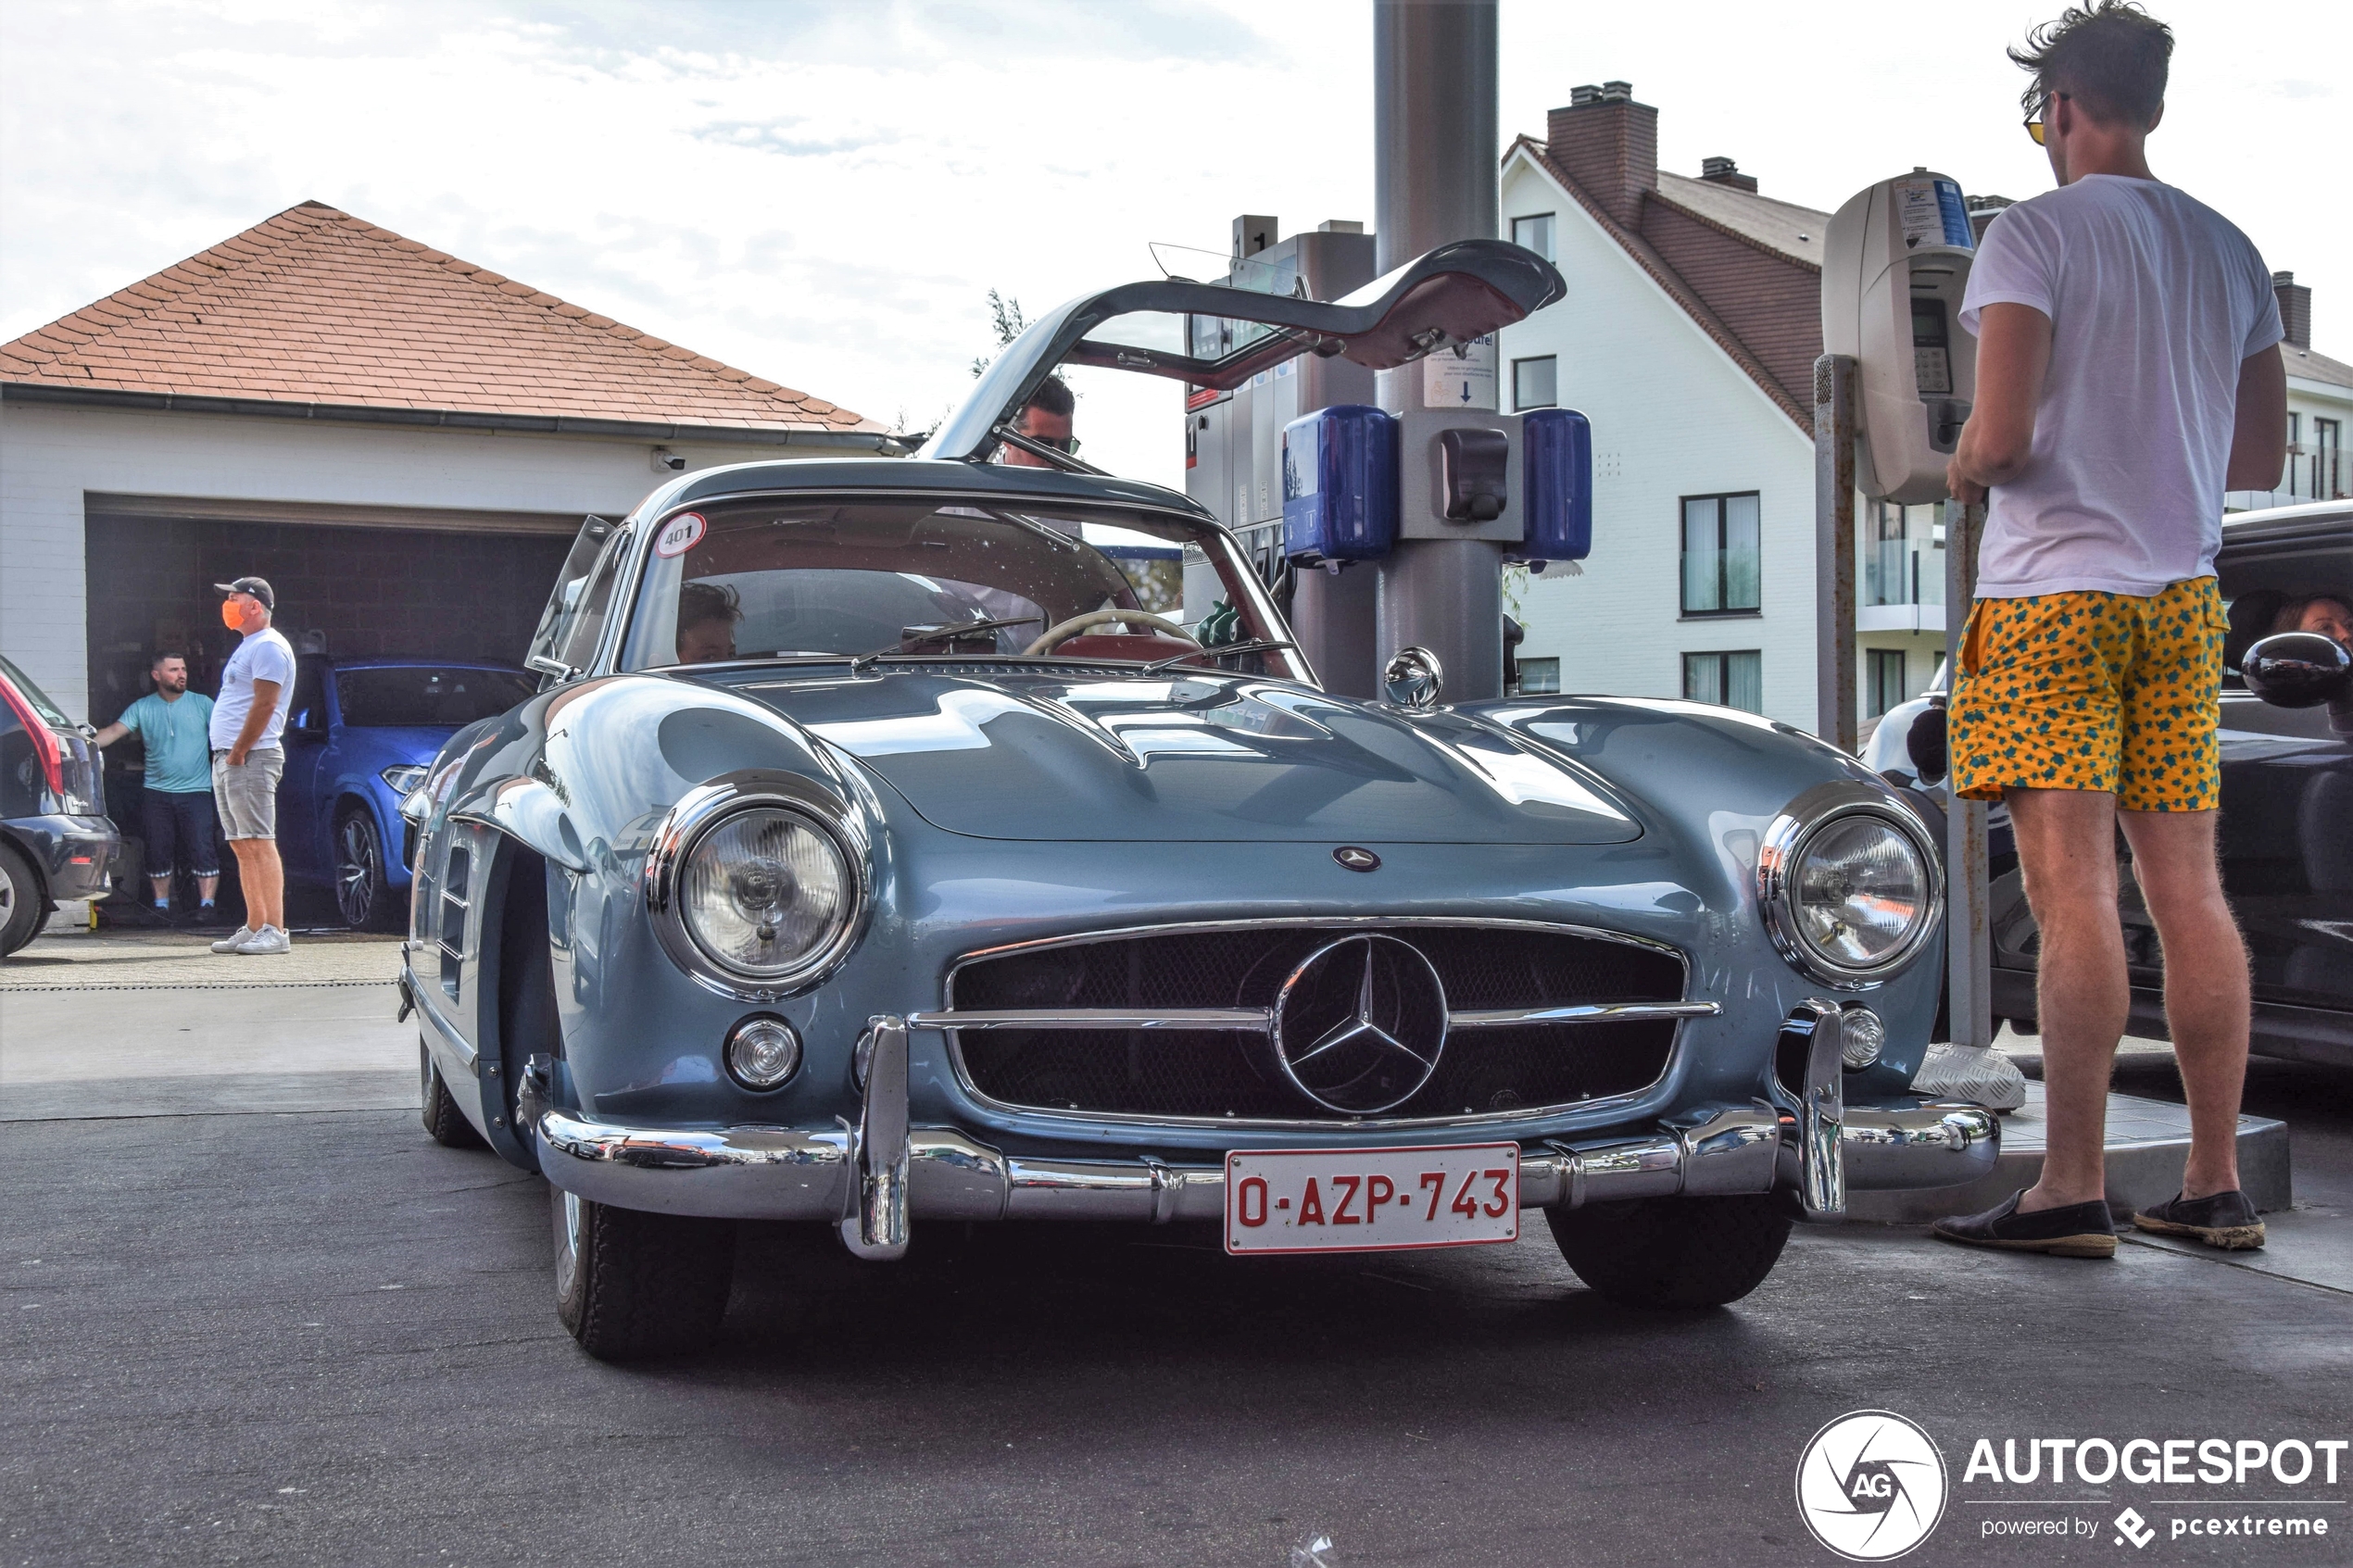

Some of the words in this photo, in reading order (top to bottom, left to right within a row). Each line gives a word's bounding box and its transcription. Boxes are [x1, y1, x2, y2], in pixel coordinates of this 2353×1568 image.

[1253, 232, 1265, 251] 1
[1188, 423, 1194, 452] 1
[665, 524, 692, 546] 401
